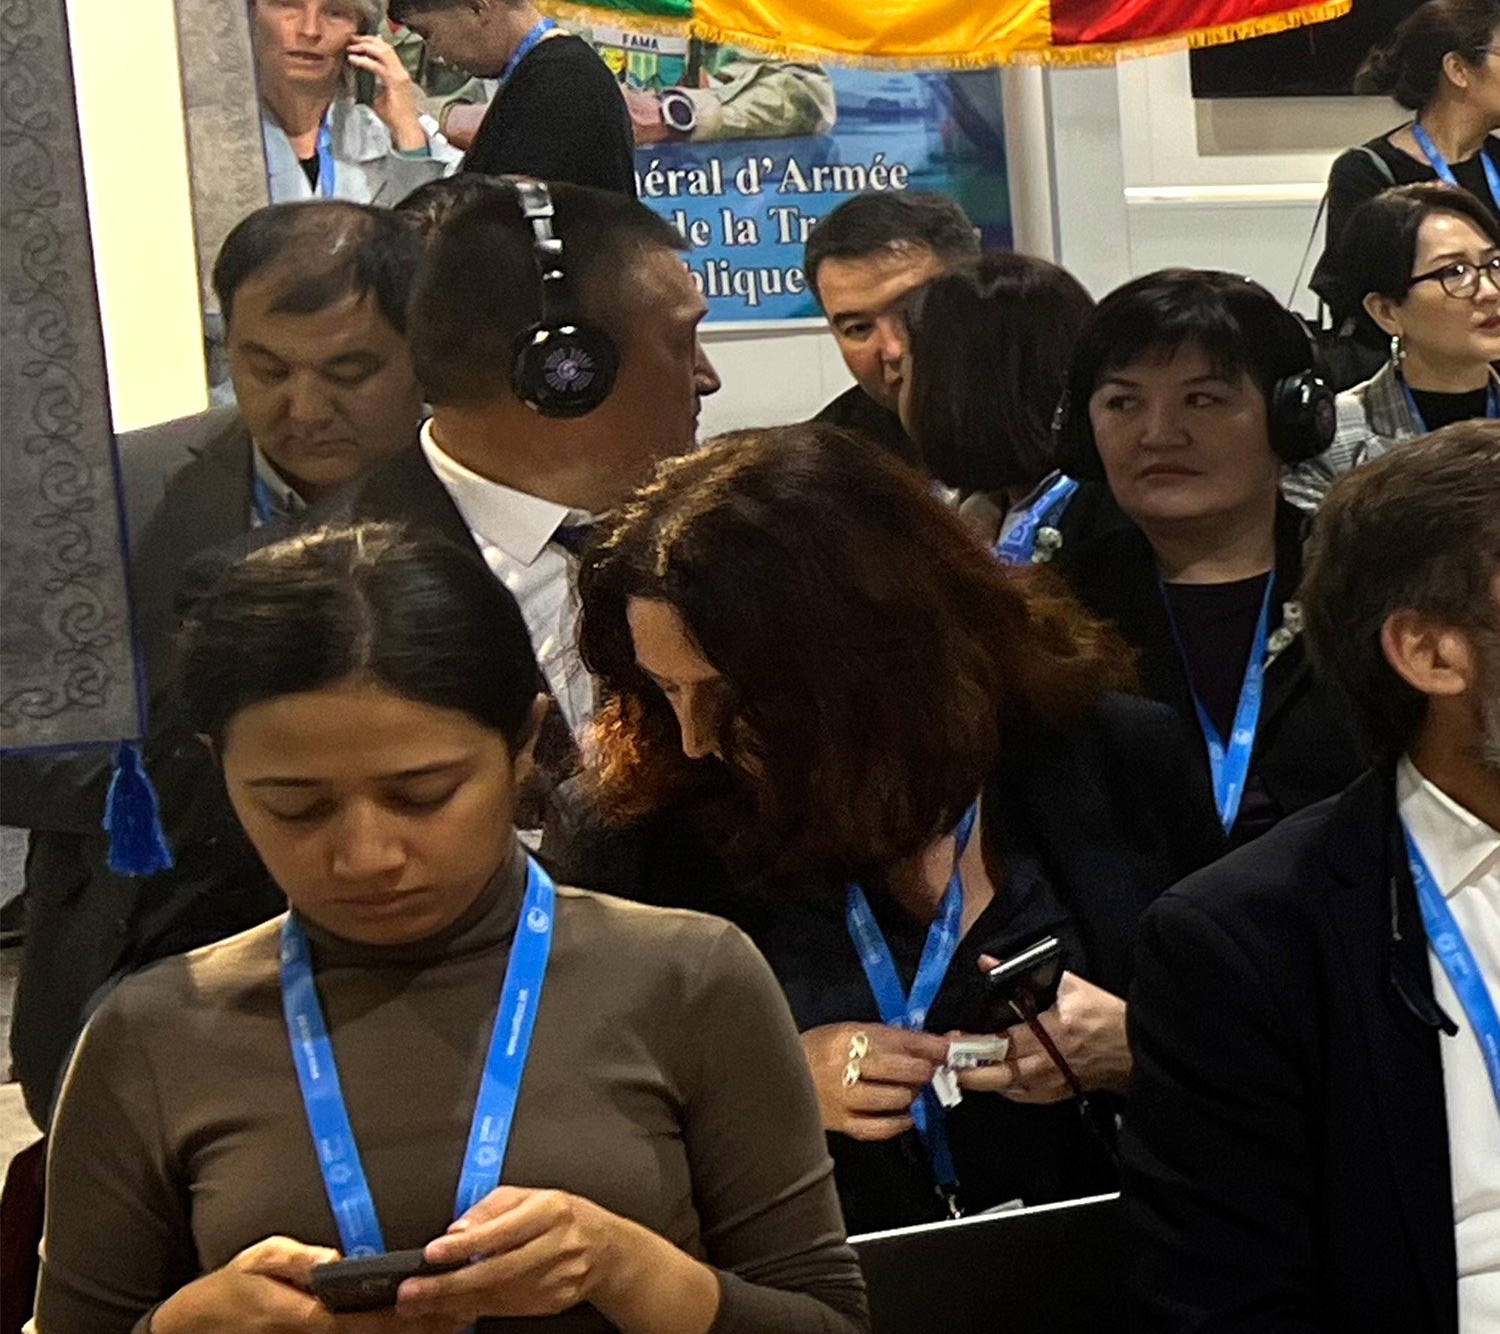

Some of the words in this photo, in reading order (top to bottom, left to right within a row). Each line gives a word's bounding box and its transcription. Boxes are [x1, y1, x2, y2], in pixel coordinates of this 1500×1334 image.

[623, 33, 660, 51] FAMA
[722, 208, 759, 245] la
[769, 206, 817, 244] Tr
